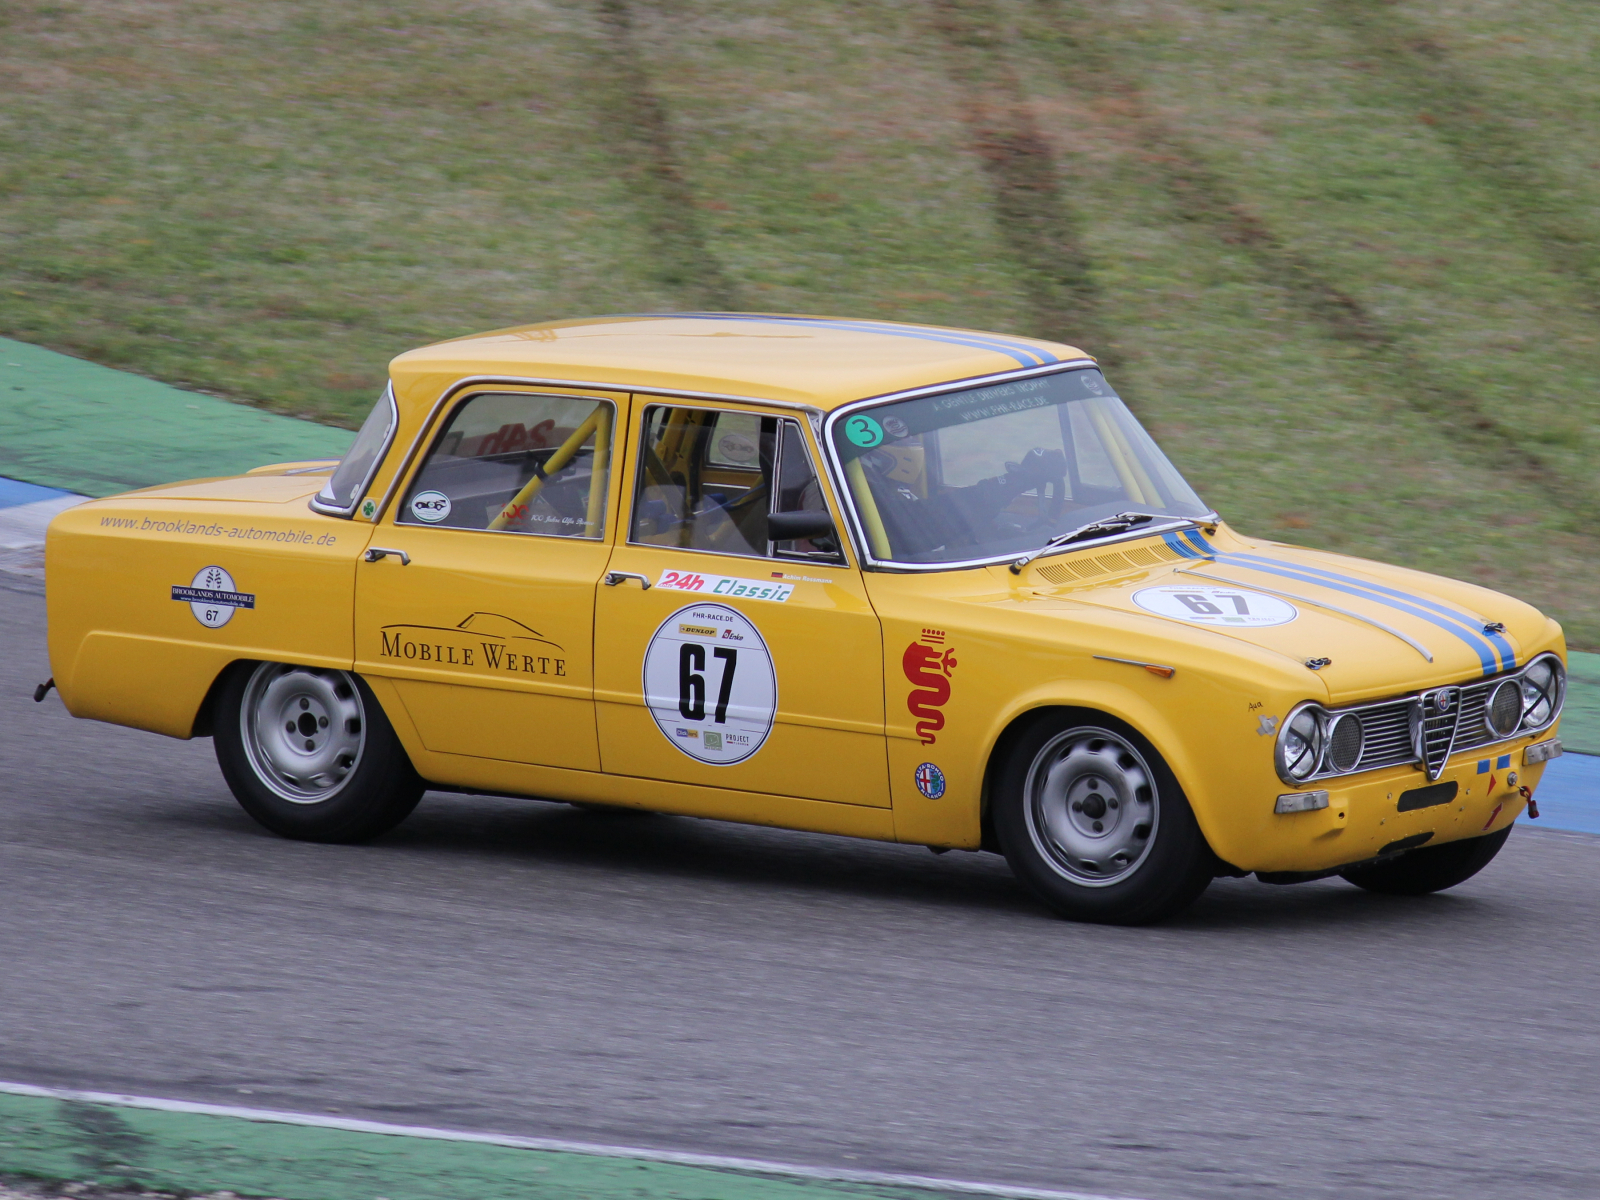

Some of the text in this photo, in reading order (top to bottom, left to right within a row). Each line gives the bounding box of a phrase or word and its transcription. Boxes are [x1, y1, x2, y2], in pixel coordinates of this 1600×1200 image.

[977, 386, 1014, 400] DRIVERS
[1015, 379, 1050, 392] TROPHY
[851, 418, 878, 445] 3
[99, 514, 337, 546] www.brooklands-automobile.de
[172, 587, 254, 602] BROOKLANDS AUTOMOBILE
[662, 572, 791, 601] 24h Classic
[1173, 594, 1251, 615] 67
[205, 609, 219, 621] 67
[692, 612, 734, 623] FHR-RACE.DE
[685, 627, 715, 635] DUNLOP
[679, 643, 738, 724] 67
[725, 733, 750, 743] PROJECT
[921, 789, 942, 799] MILANO
